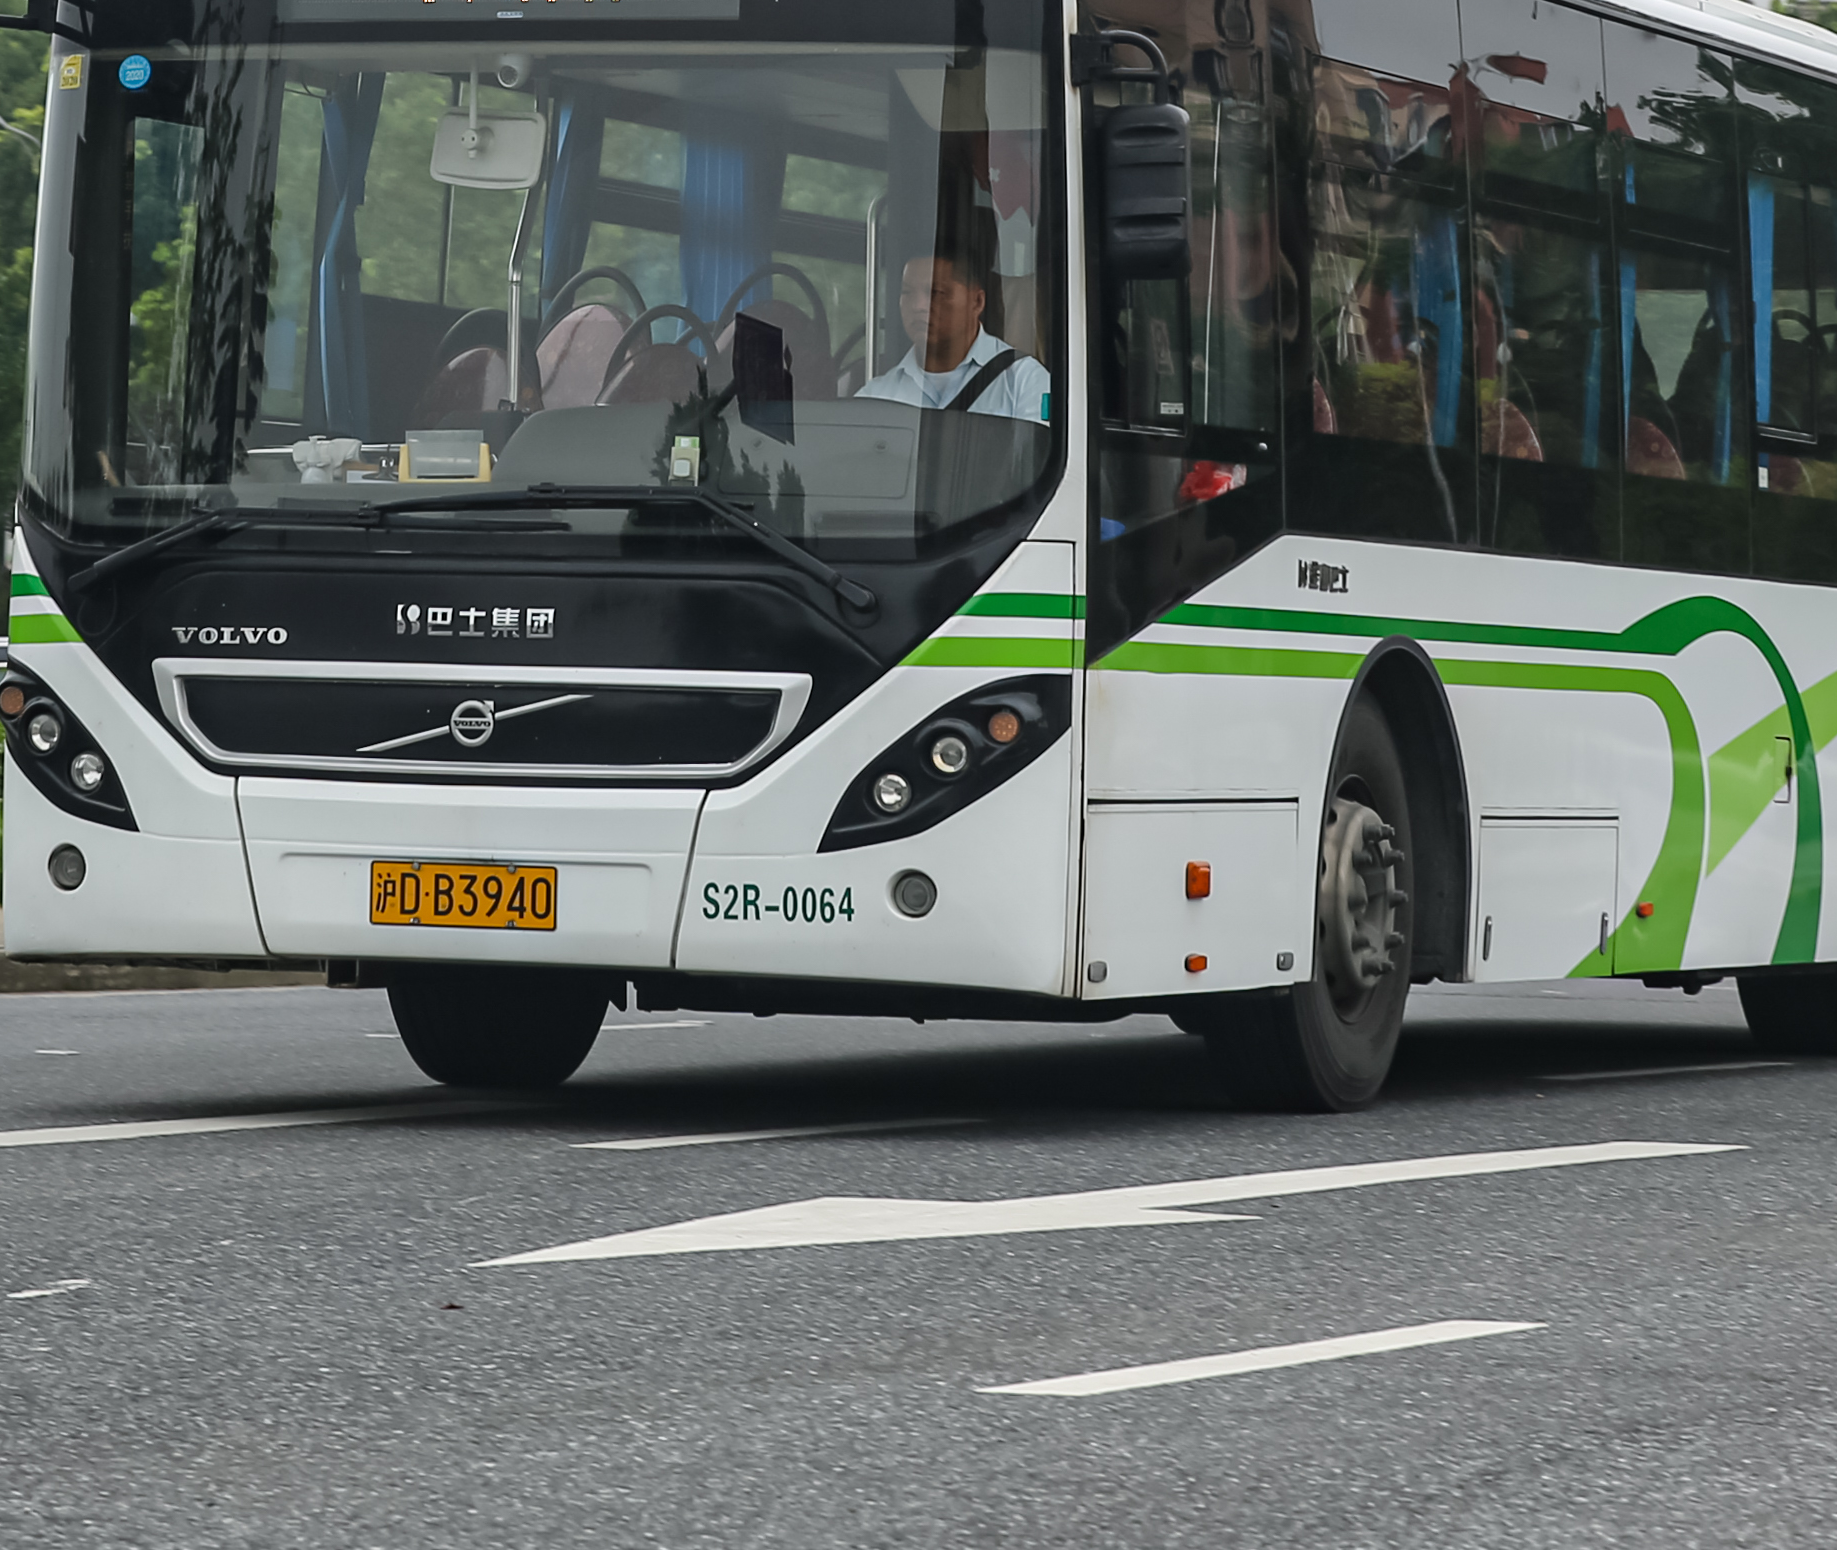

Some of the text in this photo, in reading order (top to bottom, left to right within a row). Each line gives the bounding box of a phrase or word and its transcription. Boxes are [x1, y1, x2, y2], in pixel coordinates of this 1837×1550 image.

[171, 626, 289, 646] VOLVO
[426, 605, 556, 640] 巴士集团
[453, 719, 491, 728] VOLVO
[702, 880, 856, 924] S2R-0064
